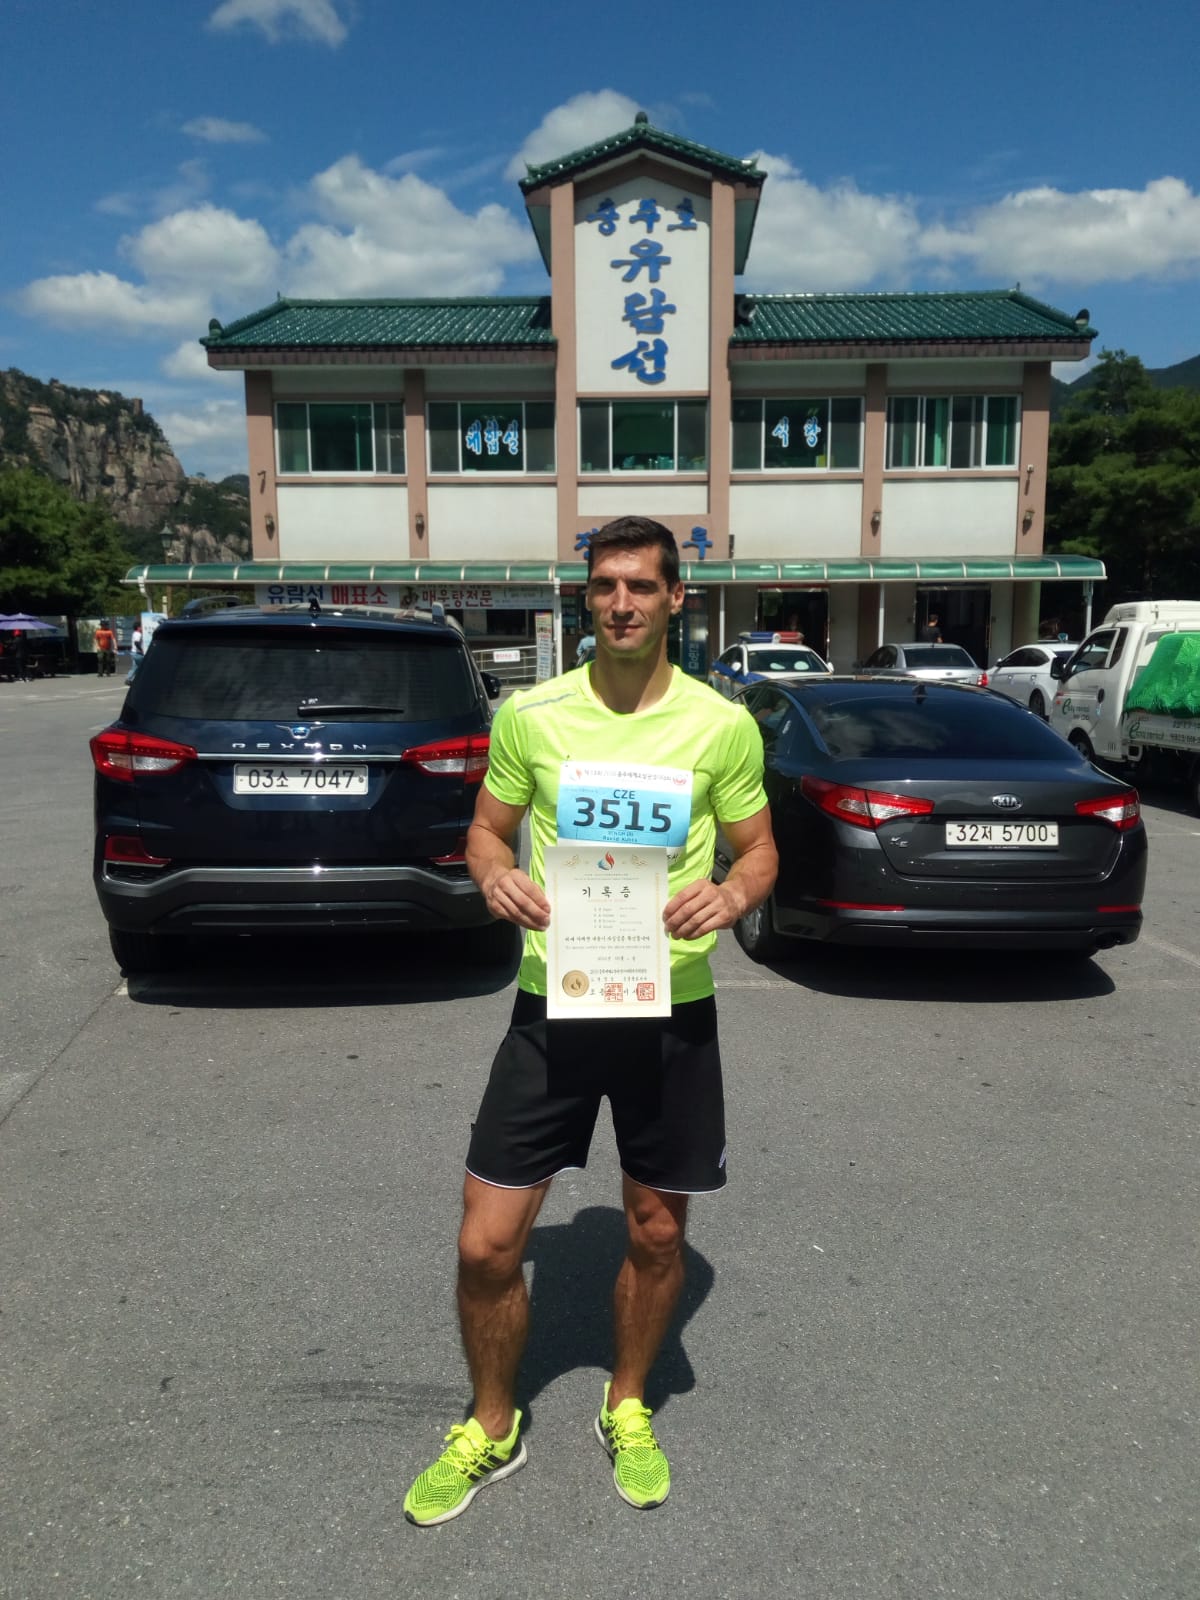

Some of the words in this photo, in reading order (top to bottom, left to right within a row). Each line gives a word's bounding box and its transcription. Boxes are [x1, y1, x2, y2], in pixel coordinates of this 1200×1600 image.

[610, 238, 677, 385] 유람선
[331, 583, 389, 605] 매표소
[247, 770, 289, 788] 03소
[301, 770, 355, 788] 7047
[613, 789, 636, 800] CZE
[998, 795, 1017, 807] KIA
[573, 796, 672, 834] 3515
[956, 824, 992, 843] 32저
[1002, 824, 1049, 843] 5700
